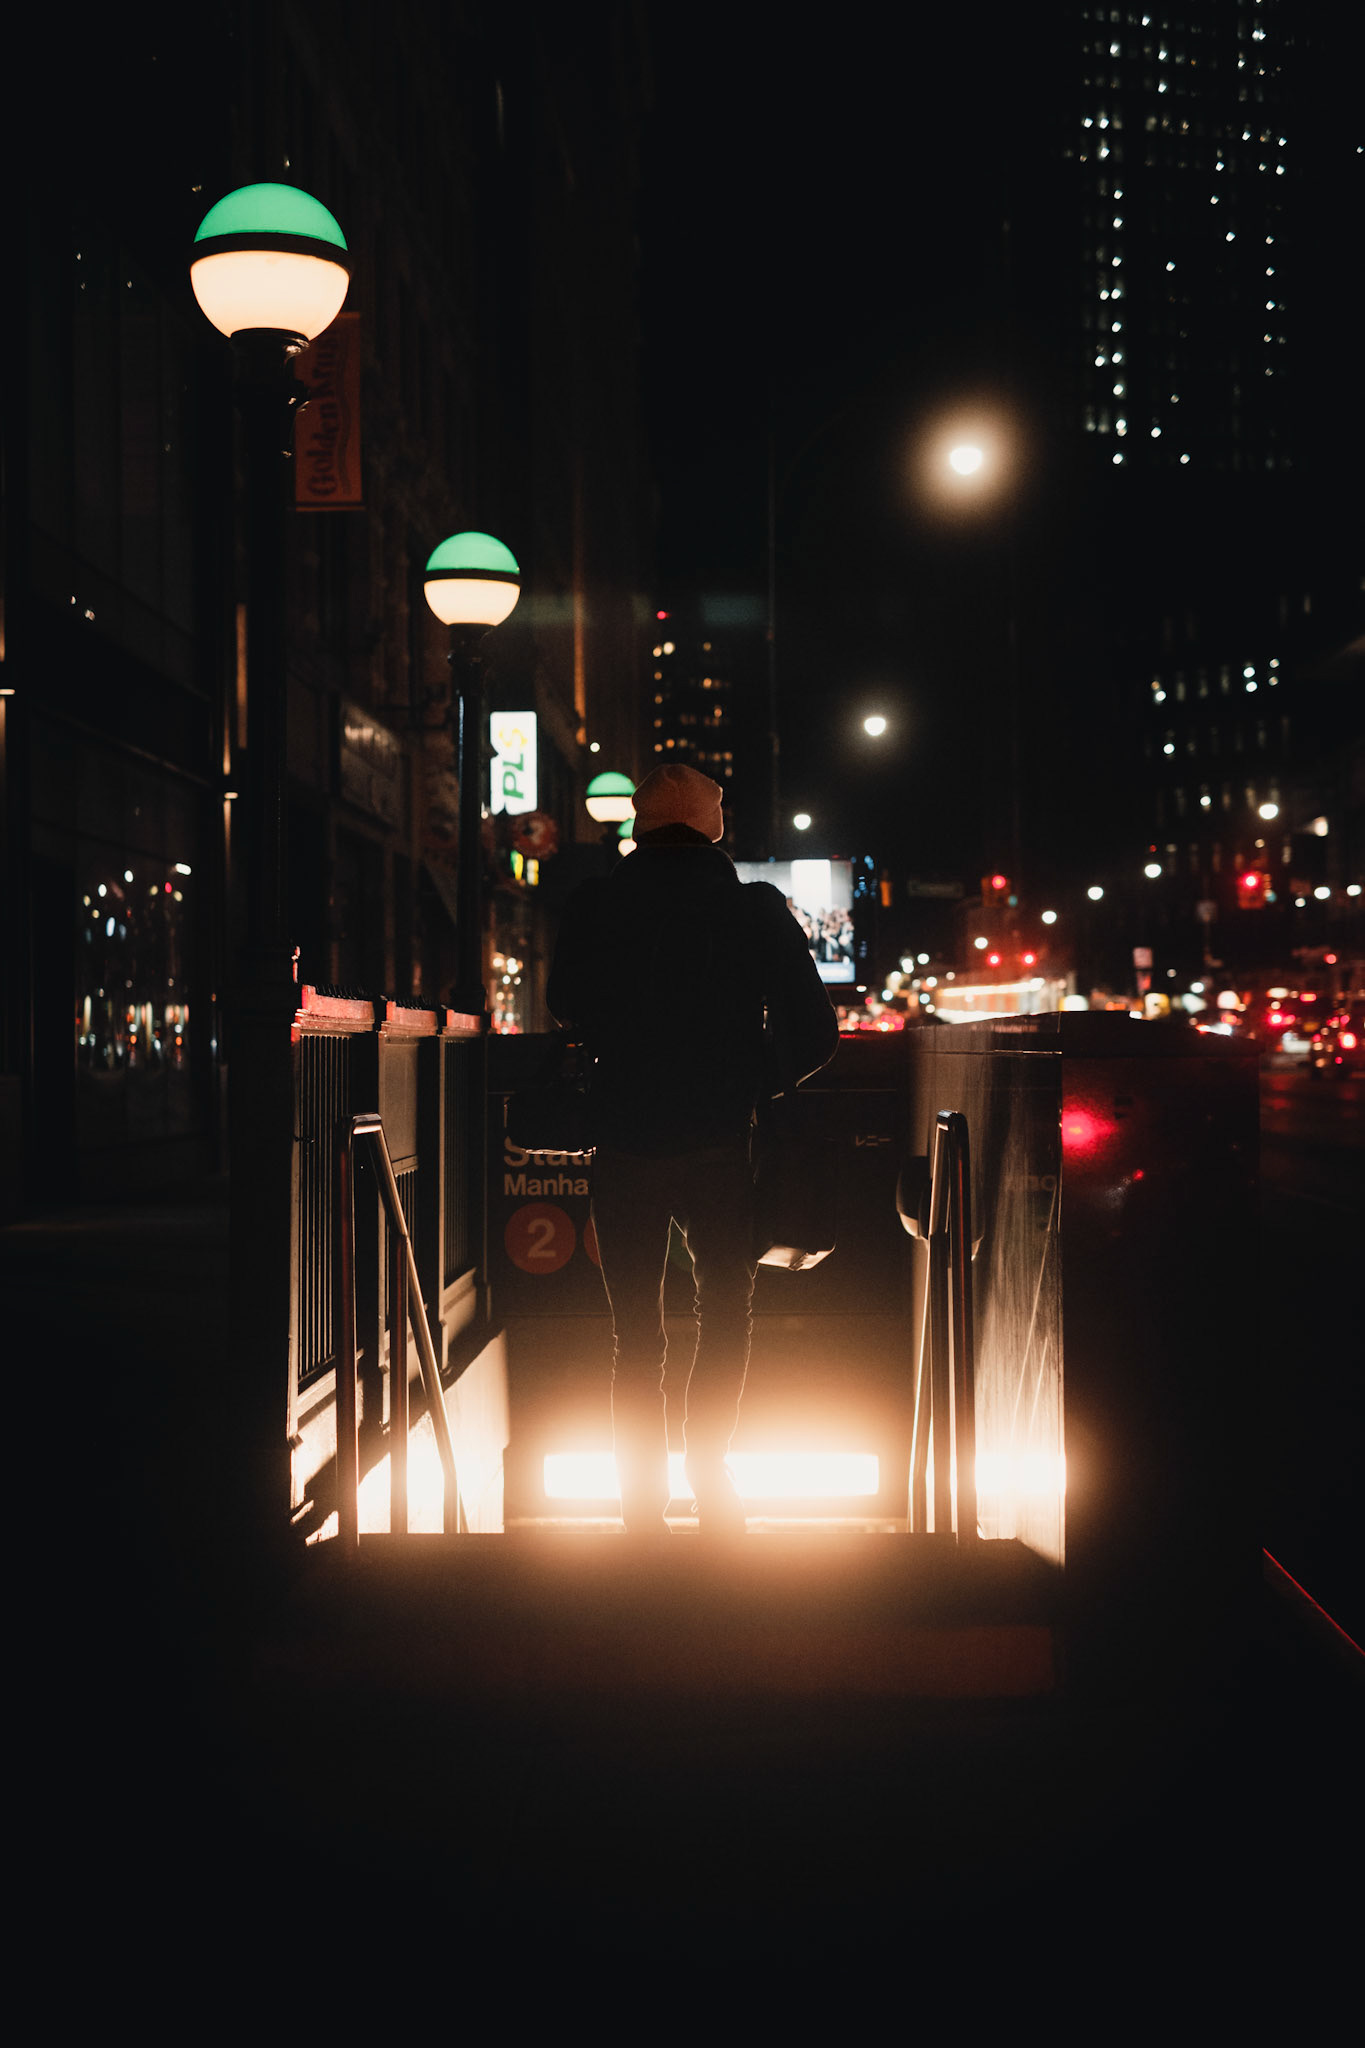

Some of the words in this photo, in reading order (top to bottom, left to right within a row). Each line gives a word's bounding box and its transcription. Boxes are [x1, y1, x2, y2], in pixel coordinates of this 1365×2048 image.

[306, 402, 339, 497] Golden
[499, 728, 528, 799] PLS
[503, 1173, 590, 1196] Manha
[527, 1217, 557, 1259] 2
